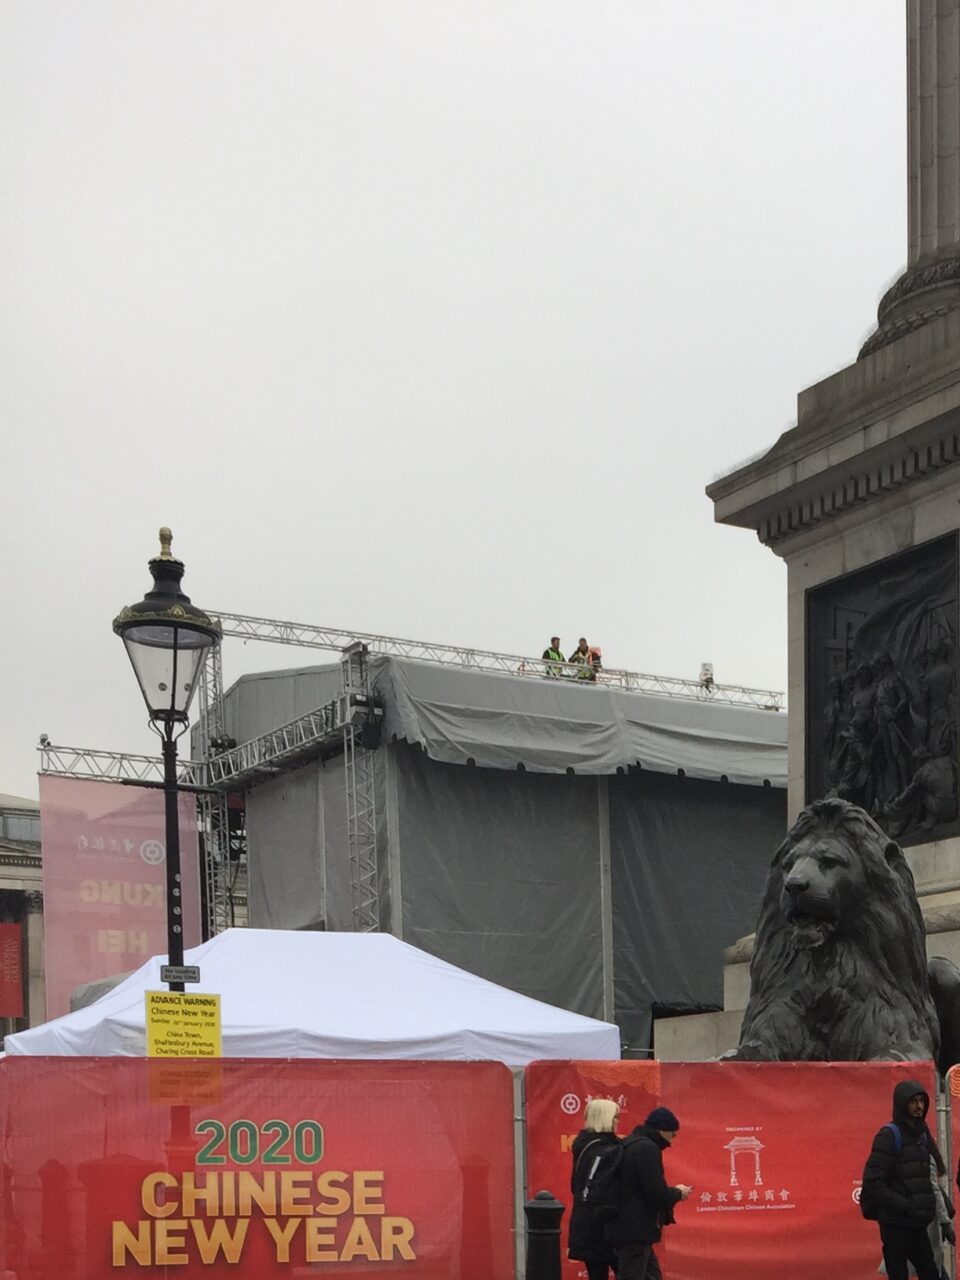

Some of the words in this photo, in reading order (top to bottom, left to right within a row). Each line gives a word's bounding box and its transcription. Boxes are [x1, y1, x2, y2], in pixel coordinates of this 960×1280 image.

[151, 996, 182, 1005] ADVANCE
[184, 998, 216, 1007] WARNING
[151, 1006, 180, 1016] Chinese
[182, 1009, 198, 1017] New
[200, 1009, 215, 1018] Year
[195, 1119, 324, 1165] 2020
[141, 1170, 386, 1218] CHINESE
[112, 1218, 249, 1266] NEW
[263, 1216, 417, 1263] YEAR
